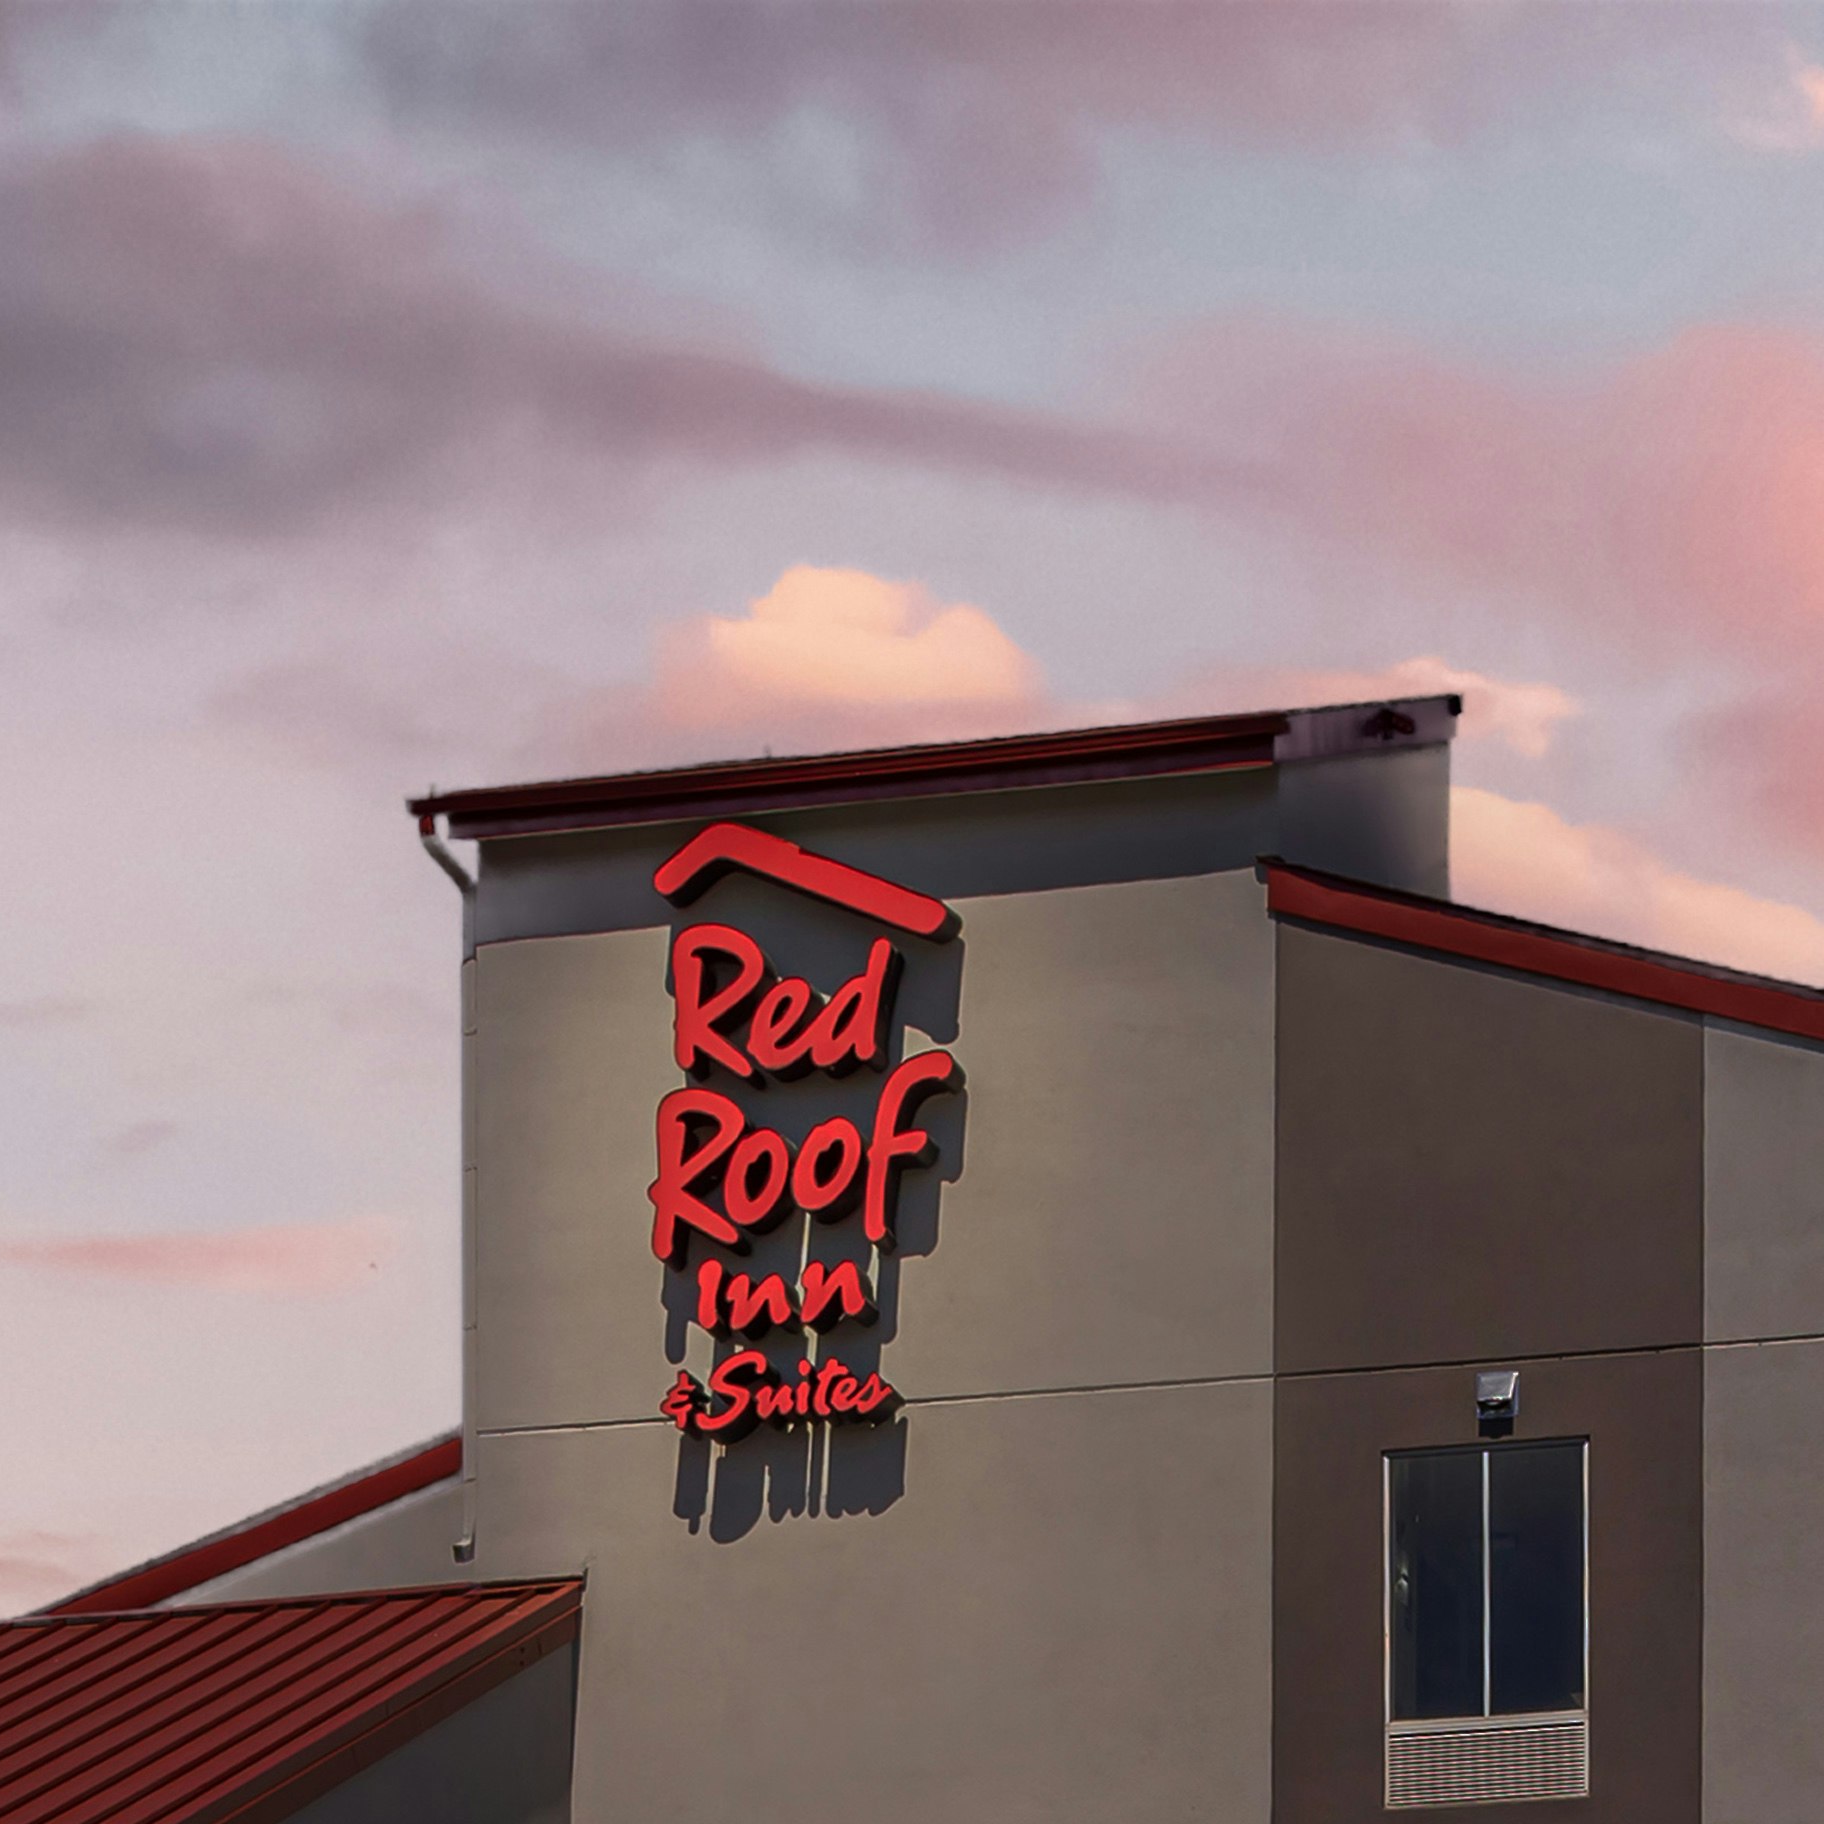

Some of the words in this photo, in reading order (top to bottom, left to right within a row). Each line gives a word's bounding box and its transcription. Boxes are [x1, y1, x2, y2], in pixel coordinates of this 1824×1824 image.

[673, 922, 892, 1078] Red
[648, 1049, 953, 1262] Roof
[697, 1258, 866, 1332] Inn
[695, 1350, 892, 1431] Suites
